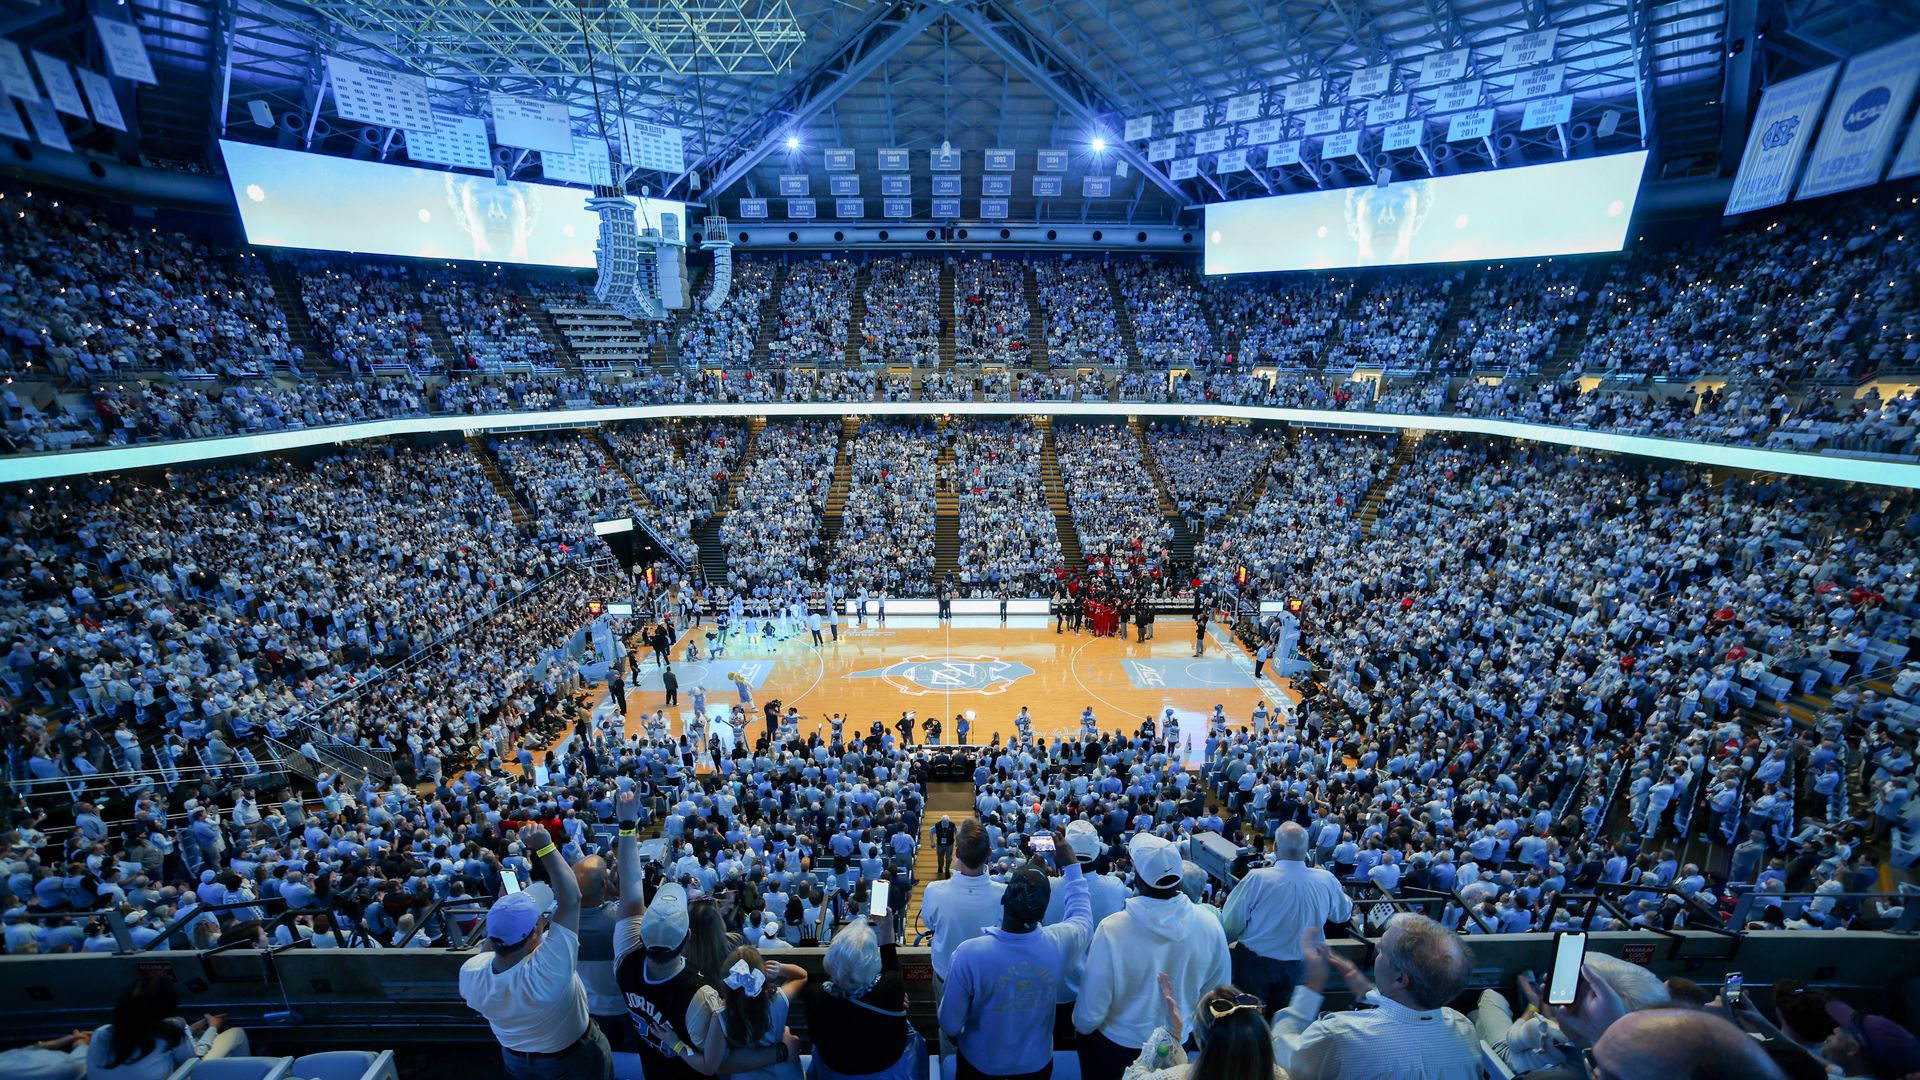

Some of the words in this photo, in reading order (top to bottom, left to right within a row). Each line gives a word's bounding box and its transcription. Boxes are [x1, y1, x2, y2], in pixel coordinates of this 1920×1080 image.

[1512, 42, 1529, 51] FINAL
[1530, 39, 1547, 48] FOUR
[1518, 51, 1536, 61] 1977
[1430, 60, 1445, 68] FINAL
[1446, 58, 1459, 66] FOUR
[1435, 70, 1451, 78] 1972
[1522, 77, 1538, 86] FINAL
[1539, 74, 1555, 82] FOUR
[1527, 84, 1546, 95] 1998
[1379, 112, 1394, 120] 1995
[1532, 108, 1547, 116] FINAL
[1536, 115, 1556, 125] 2022
[1818, 148, 1873, 178] 1957
